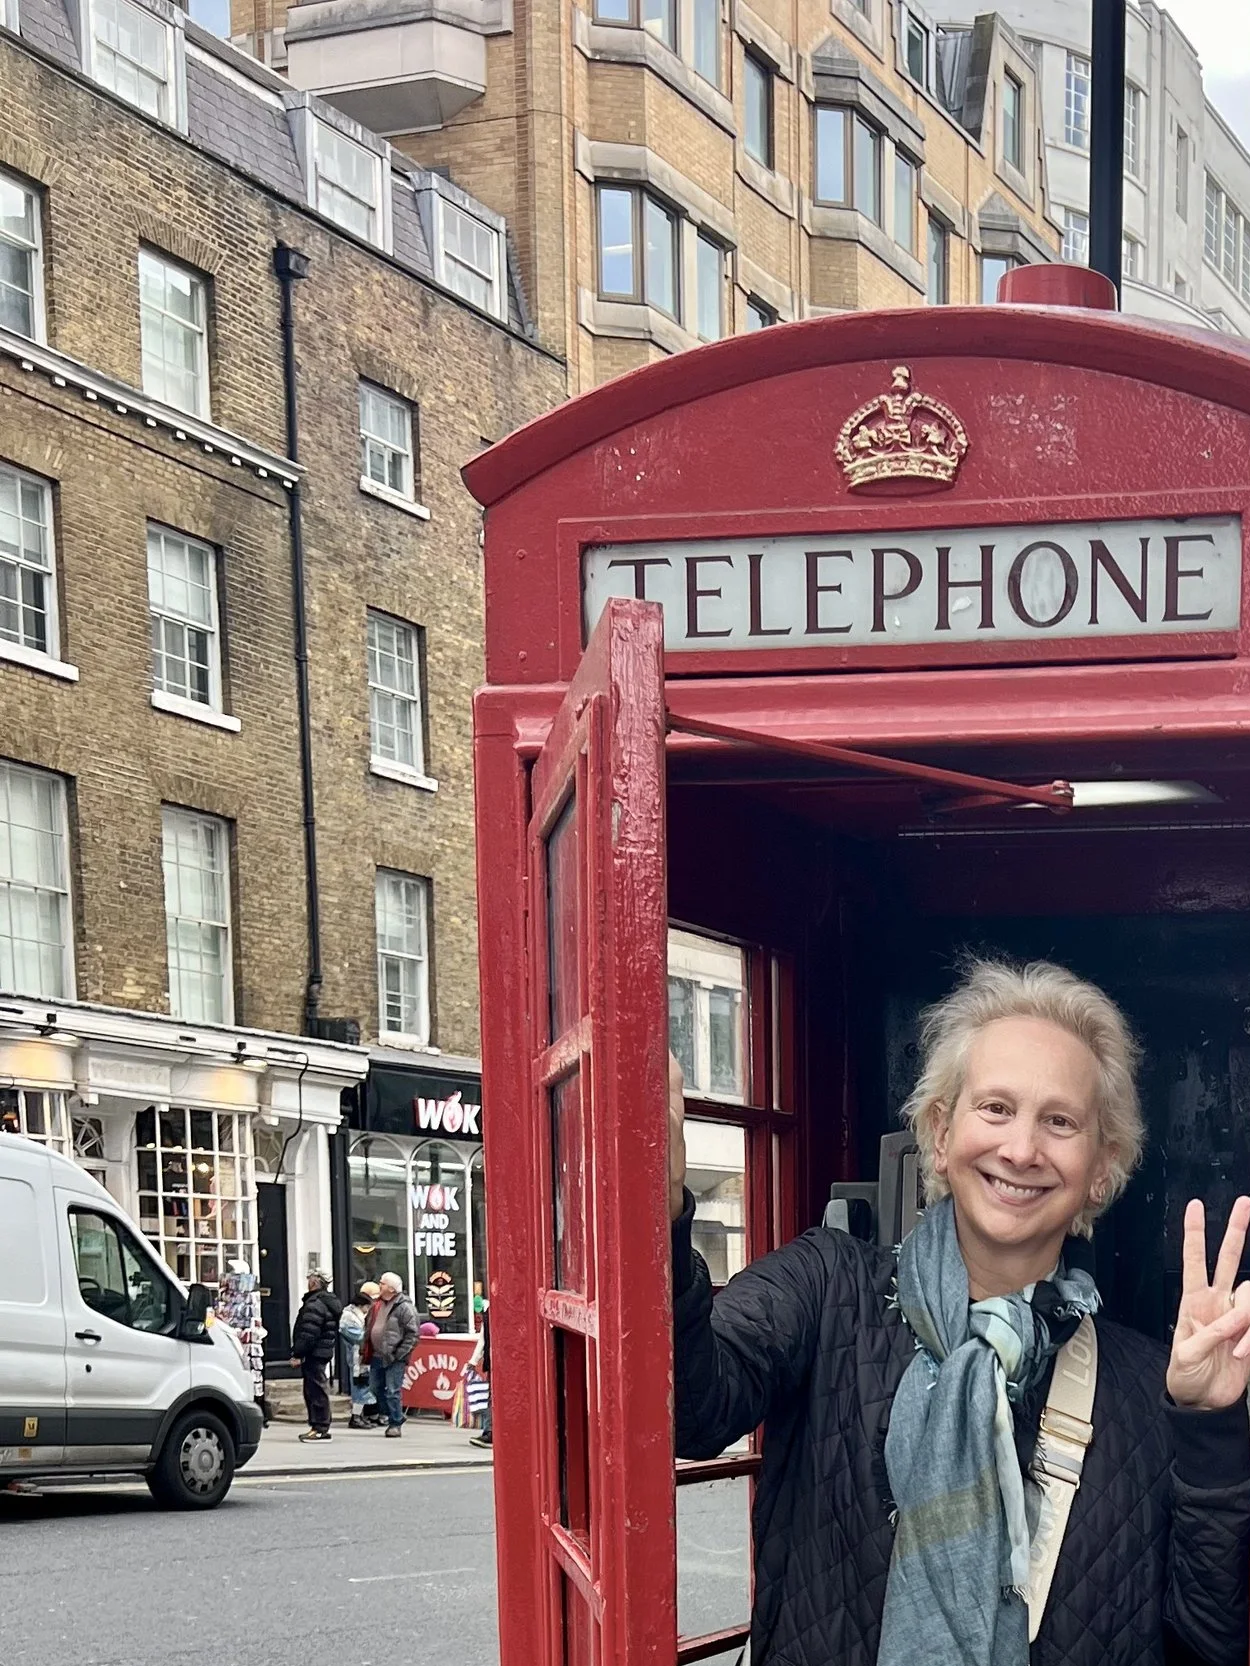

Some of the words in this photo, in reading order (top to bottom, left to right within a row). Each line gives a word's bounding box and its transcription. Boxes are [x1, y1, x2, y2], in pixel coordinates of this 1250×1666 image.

[607, 534, 1217, 638] TELEPHONE
[416, 1090, 481, 1135] WOK
[410, 1183, 460, 1211] WOK
[420, 1213, 449, 1230] AND
[414, 1232, 457, 1257] FIRE
[401, 1358, 428, 1391] WOK
[428, 1354, 459, 1372] AND
